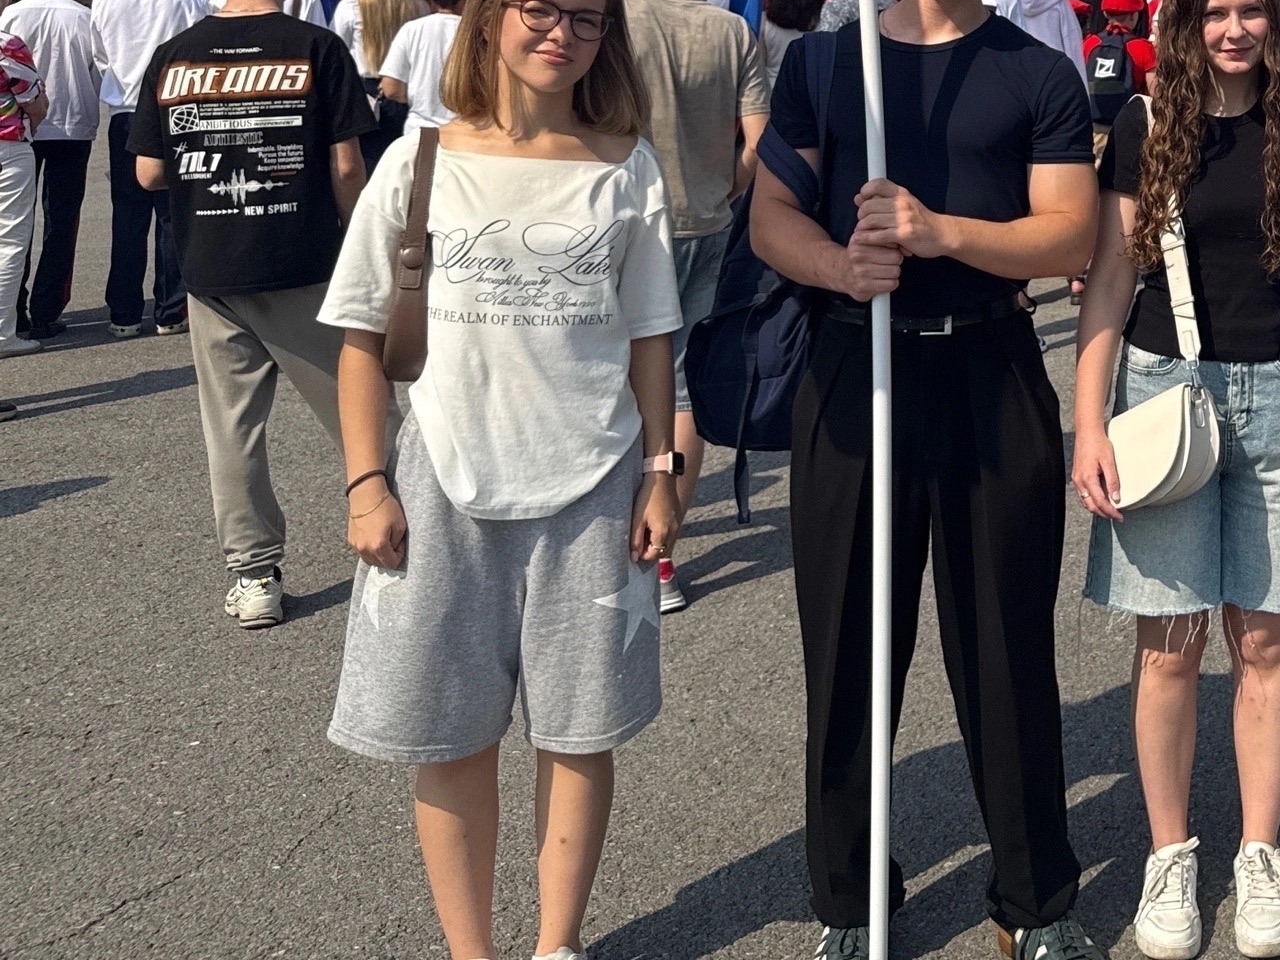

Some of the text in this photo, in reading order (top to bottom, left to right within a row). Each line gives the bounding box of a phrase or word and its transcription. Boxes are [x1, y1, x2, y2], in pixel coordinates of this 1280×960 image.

[160, 65, 309, 100] DREAMS
[200, 119, 253, 129] AMBITIOUS
[203, 131, 263, 147] AUTHENTIC
[244, 202, 298, 216] NEW SPIRIT
[430, 219, 516, 284] Swan
[444, 308, 488, 325] REALM
[491, 313, 510, 327] OF
[512, 313, 614, 327] ENCHANTMENT
